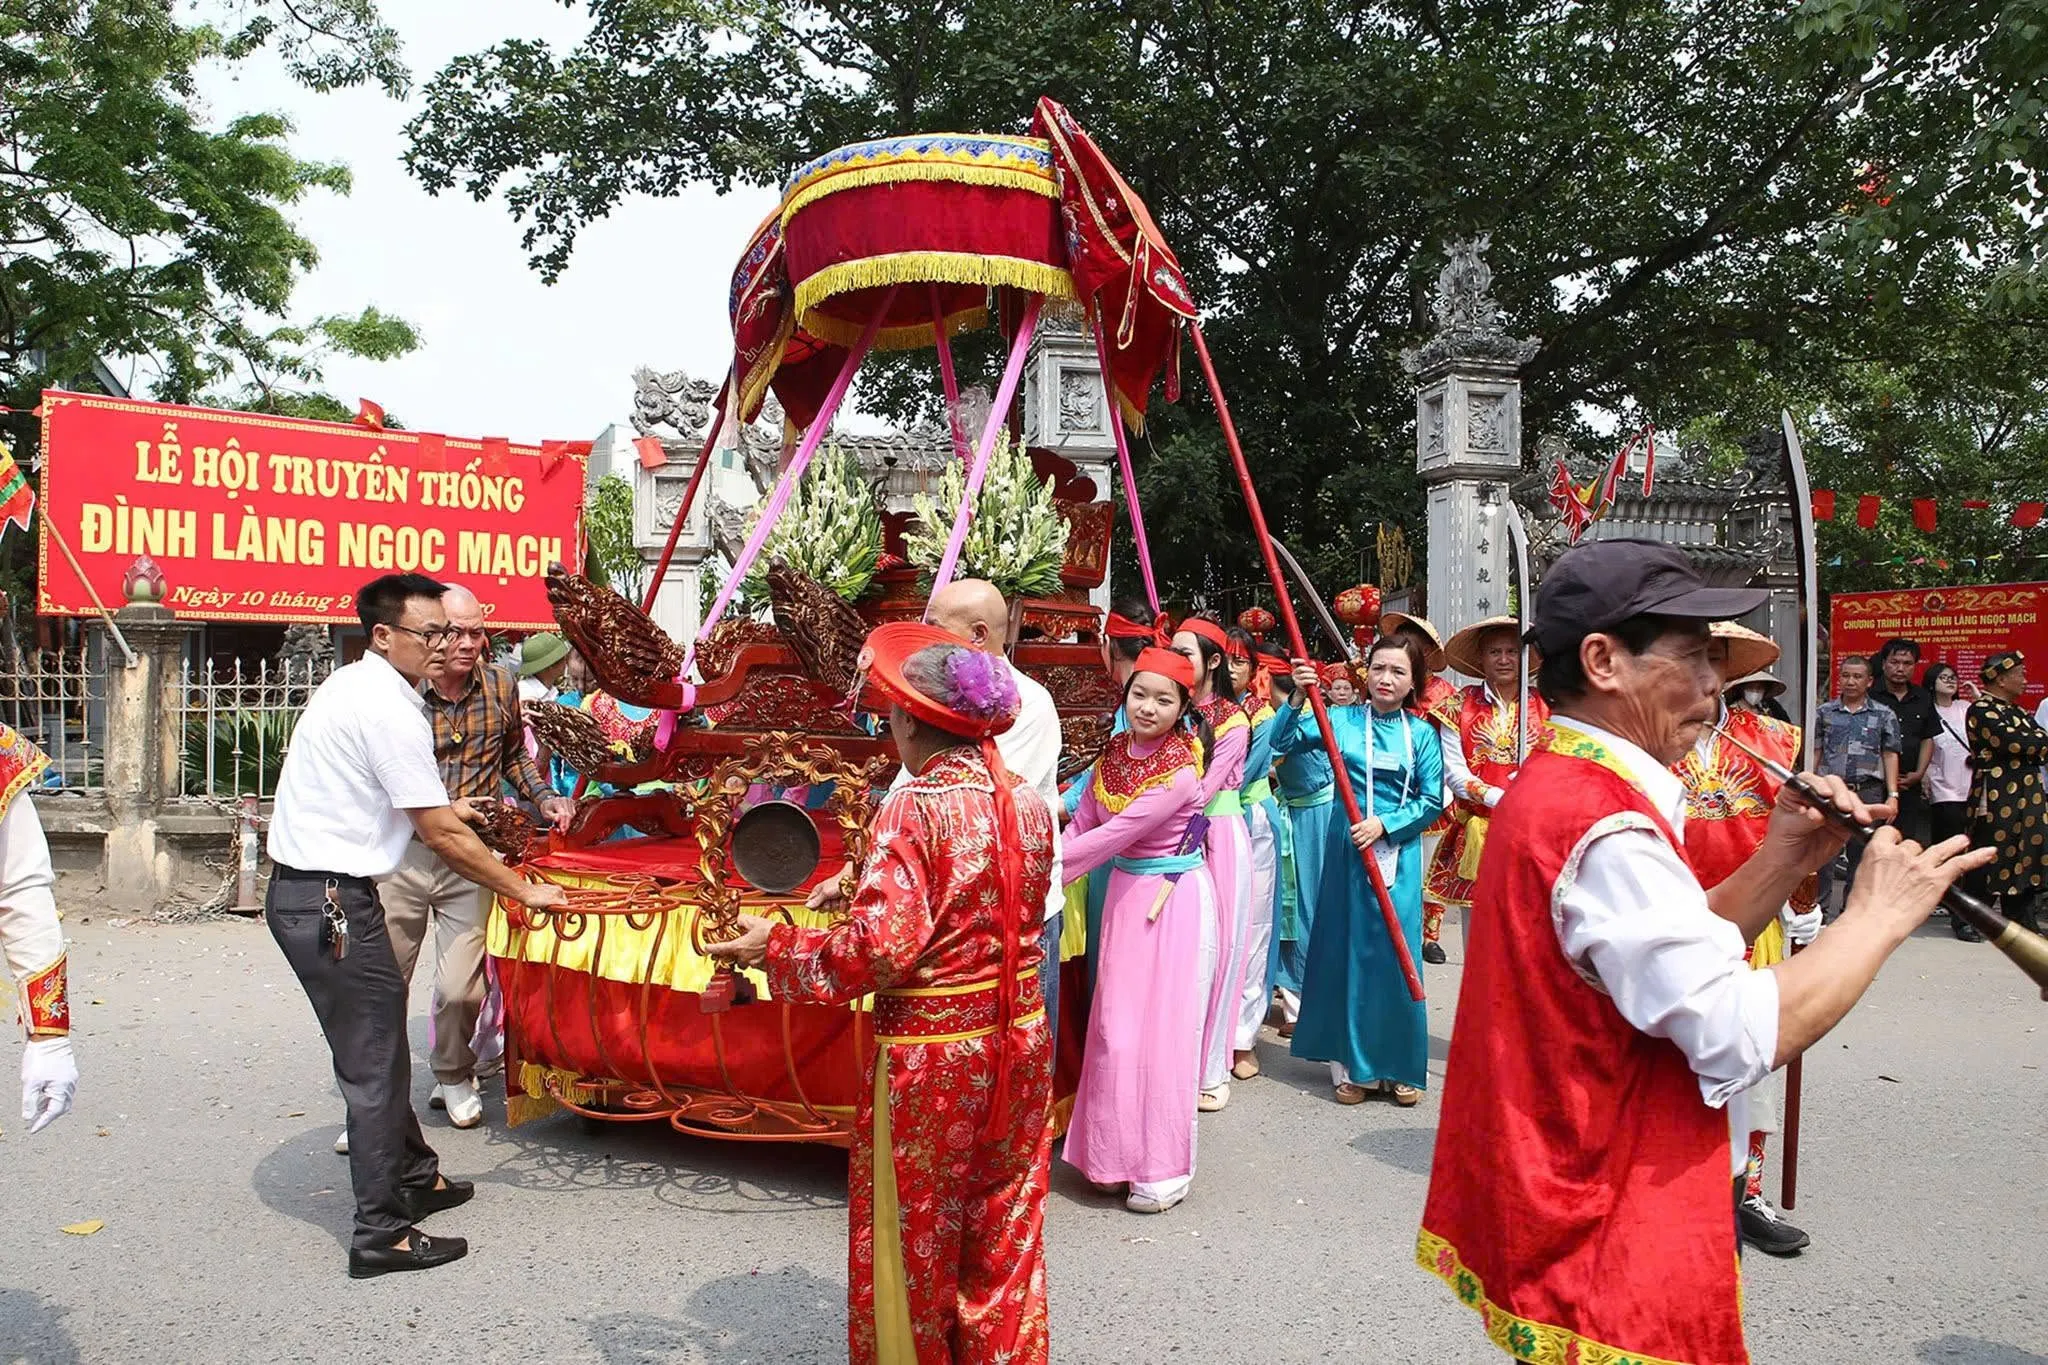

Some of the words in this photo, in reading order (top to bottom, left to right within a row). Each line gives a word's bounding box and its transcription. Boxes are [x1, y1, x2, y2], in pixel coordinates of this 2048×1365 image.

[135, 422, 183, 484] LỄ
[192, 437, 260, 499] HỘI
[268, 445, 410, 504] TRUYỀN
[417, 457, 525, 513] THỐNG
[80, 494, 196, 558] ĐÌNH
[212, 505, 325, 566] LÀNG
[458, 530, 561, 585] MẠCH
[170, 586, 235, 608] Ngày
[238, 591, 265, 606] 10
[269, 590, 334, 611] tháng
[336, 595, 352, 609] 2
[2008, 613, 2037, 626] MẠCH
